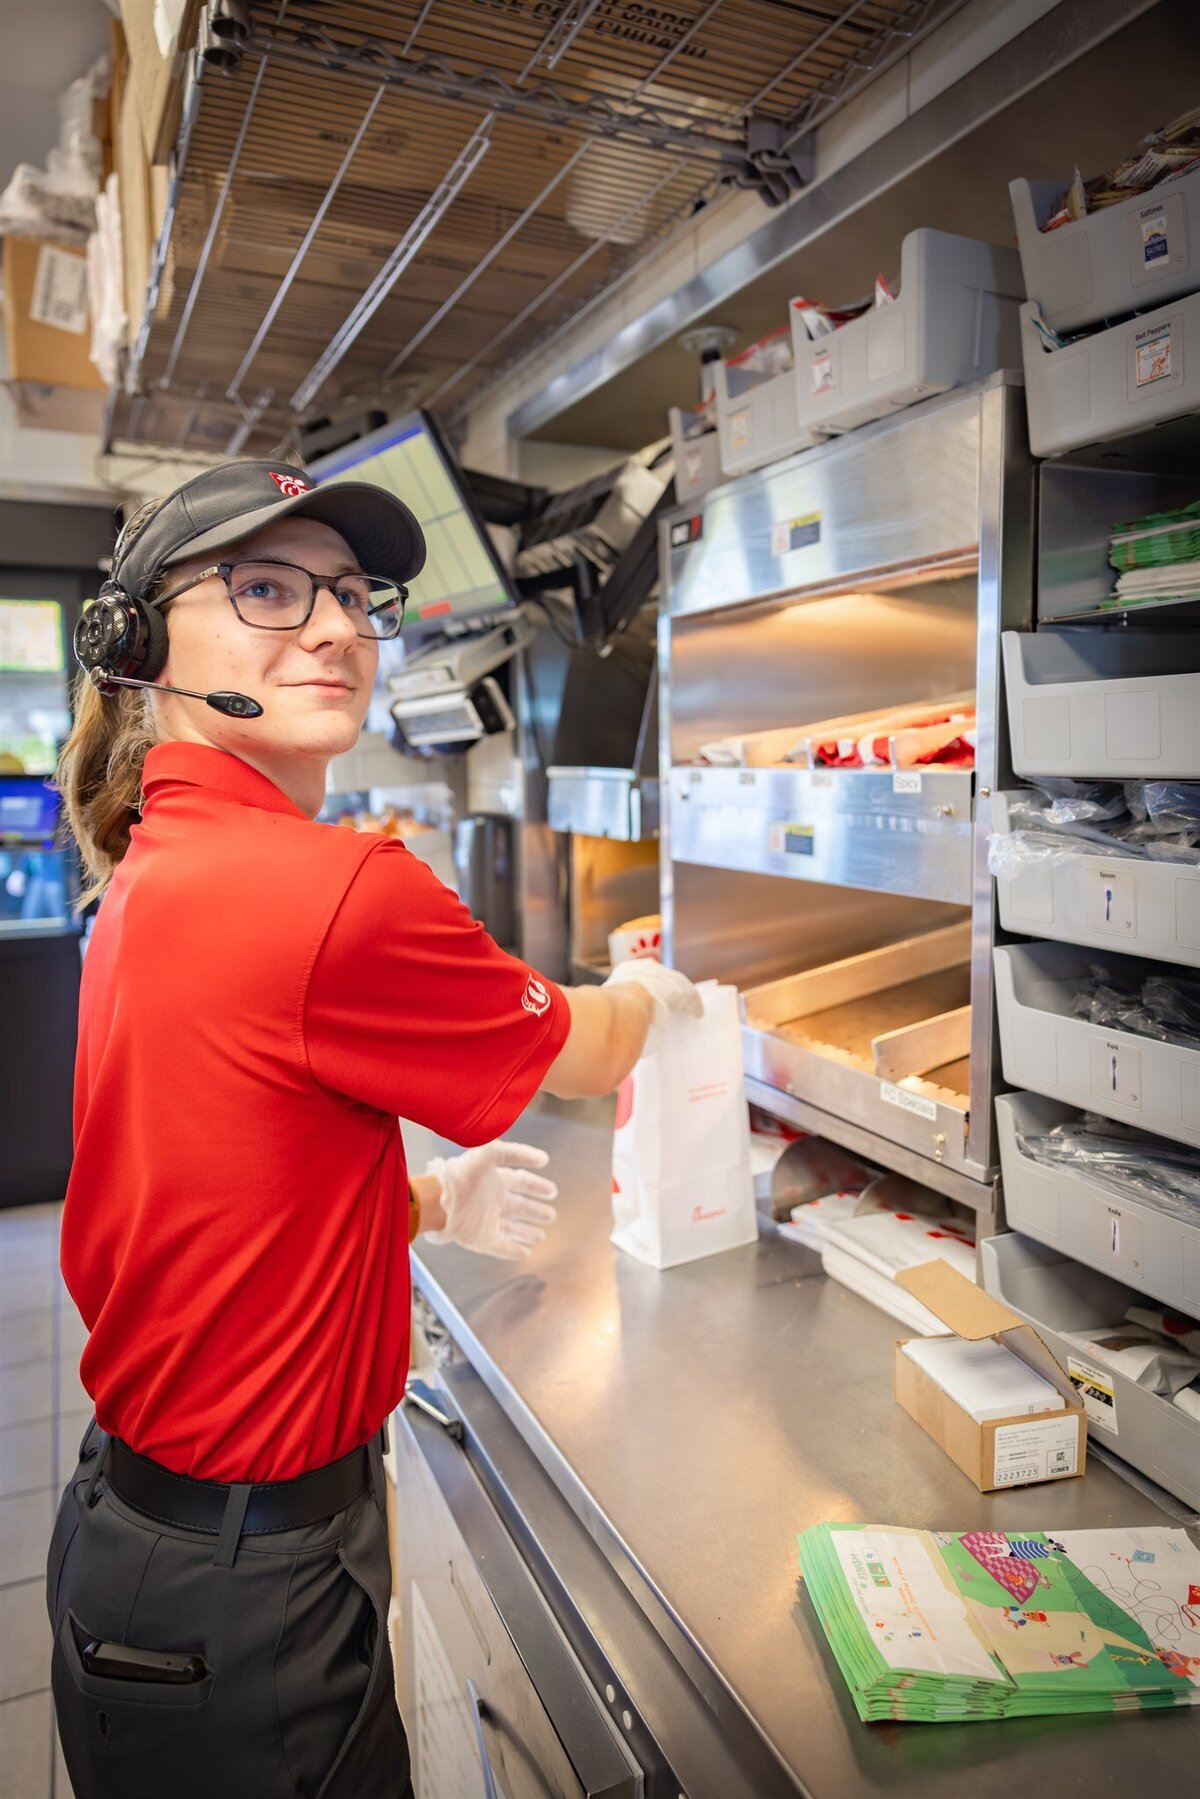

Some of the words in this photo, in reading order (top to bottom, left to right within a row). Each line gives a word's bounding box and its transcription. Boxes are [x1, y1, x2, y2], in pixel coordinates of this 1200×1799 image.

[1140, 204, 1164, 219] Saltines
[1135, 331, 1147, 342] Bell
[1147, 322, 1172, 337] Peppers
[1099, 871, 1116, 880] Spoon
[1106, 1042, 1119, 1051] Fork
